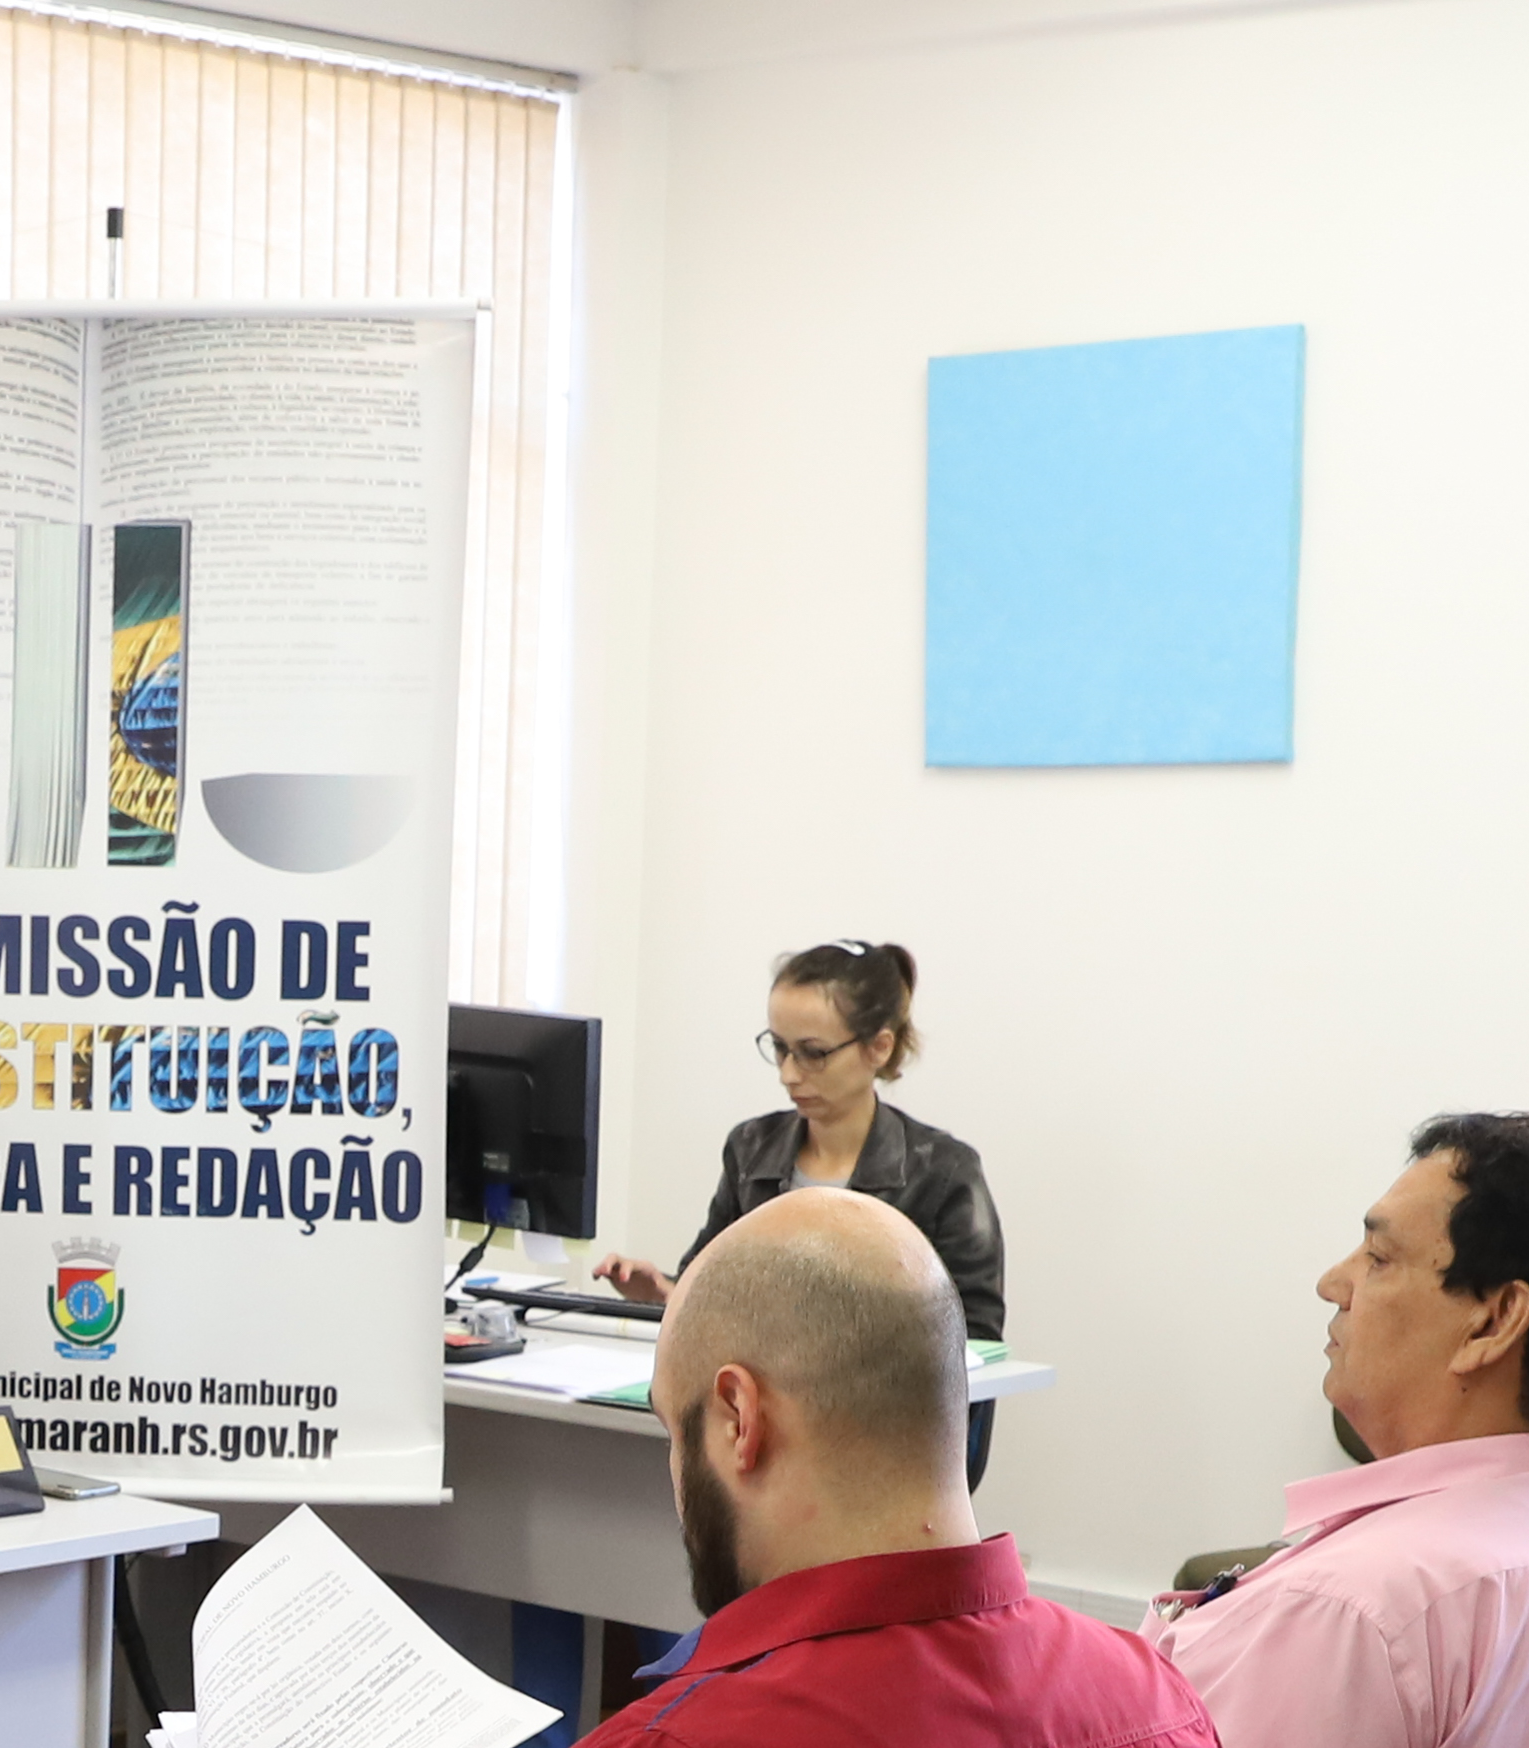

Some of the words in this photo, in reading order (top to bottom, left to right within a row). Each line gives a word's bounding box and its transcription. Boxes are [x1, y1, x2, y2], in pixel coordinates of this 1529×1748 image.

[280, 920, 371, 1002] DE
[61, 1144, 93, 1214] E
[113, 1135, 423, 1235] REDAÇÃO
[90, 1375, 121, 1400] de
[128, 1376, 192, 1404] Novo
[201, 1378, 339, 1410] Hamburgo
[244, 1555, 290, 1591] HAMBURGO
